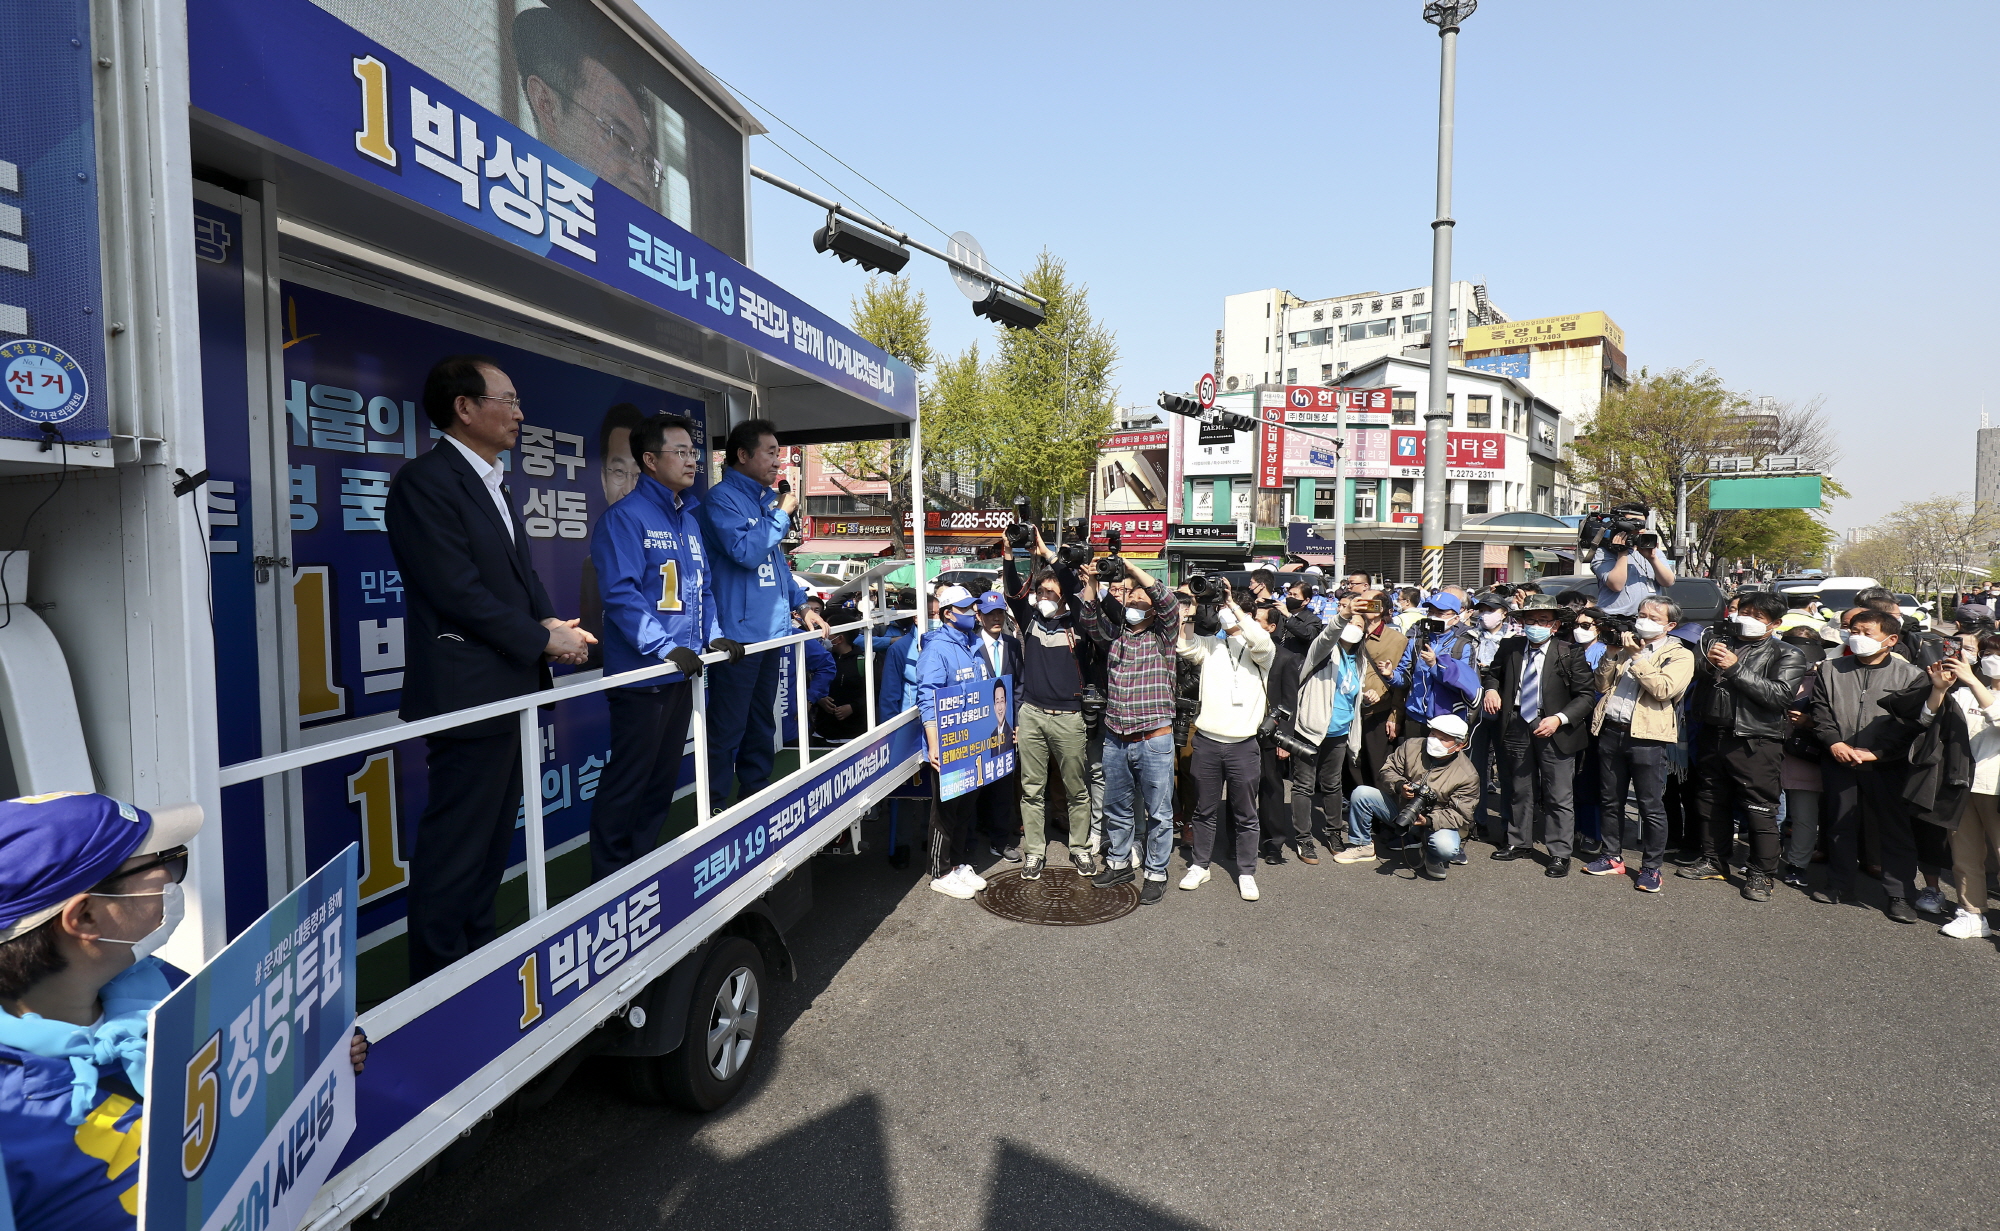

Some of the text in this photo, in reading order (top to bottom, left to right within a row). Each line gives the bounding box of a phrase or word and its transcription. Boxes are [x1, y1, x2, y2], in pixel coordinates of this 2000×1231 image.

[354, 55, 597, 263] 1 박성준
[628, 223, 895, 397] 코로나 19 국민과 함께 이겨내겠습니다
[8, 371, 64, 395] 선거
[1202, 382, 1213, 400] 50
[30, 393, 83, 419] 선거관리위원회
[521, 424, 586, 480] 중구
[1421, 438, 1498, 460] 신타올
[1450, 469, 1495, 479] T.2273-2311
[523, 488, 587, 539] 성동
[951, 512, 1014, 528] 2285-5568
[360, 570, 404, 604] 민주
[657, 560, 682, 611] 1
[939, 691, 980, 712] 대한민국 국민
[940, 705, 990, 729] 모두가 영웅입니다
[942, 729, 969, 747] 코로나19
[942, 747, 968, 765] 함께하면
[970, 740, 986, 756] 반드시
[976, 755, 984, 787] 1
[985, 752, 1013, 780] 박성준
[693, 743, 890, 899] 코로나 19 국민과 함께 이겨내겠습니다
[264, 933, 291, 980] 문재인
[294, 902, 326, 947] 대통령과
[328, 887, 342, 918] 함께
[518, 880, 661, 1029] 1 박성준
[227, 913, 342, 1118] 정당투표
[182, 1029, 222, 1181] 5
